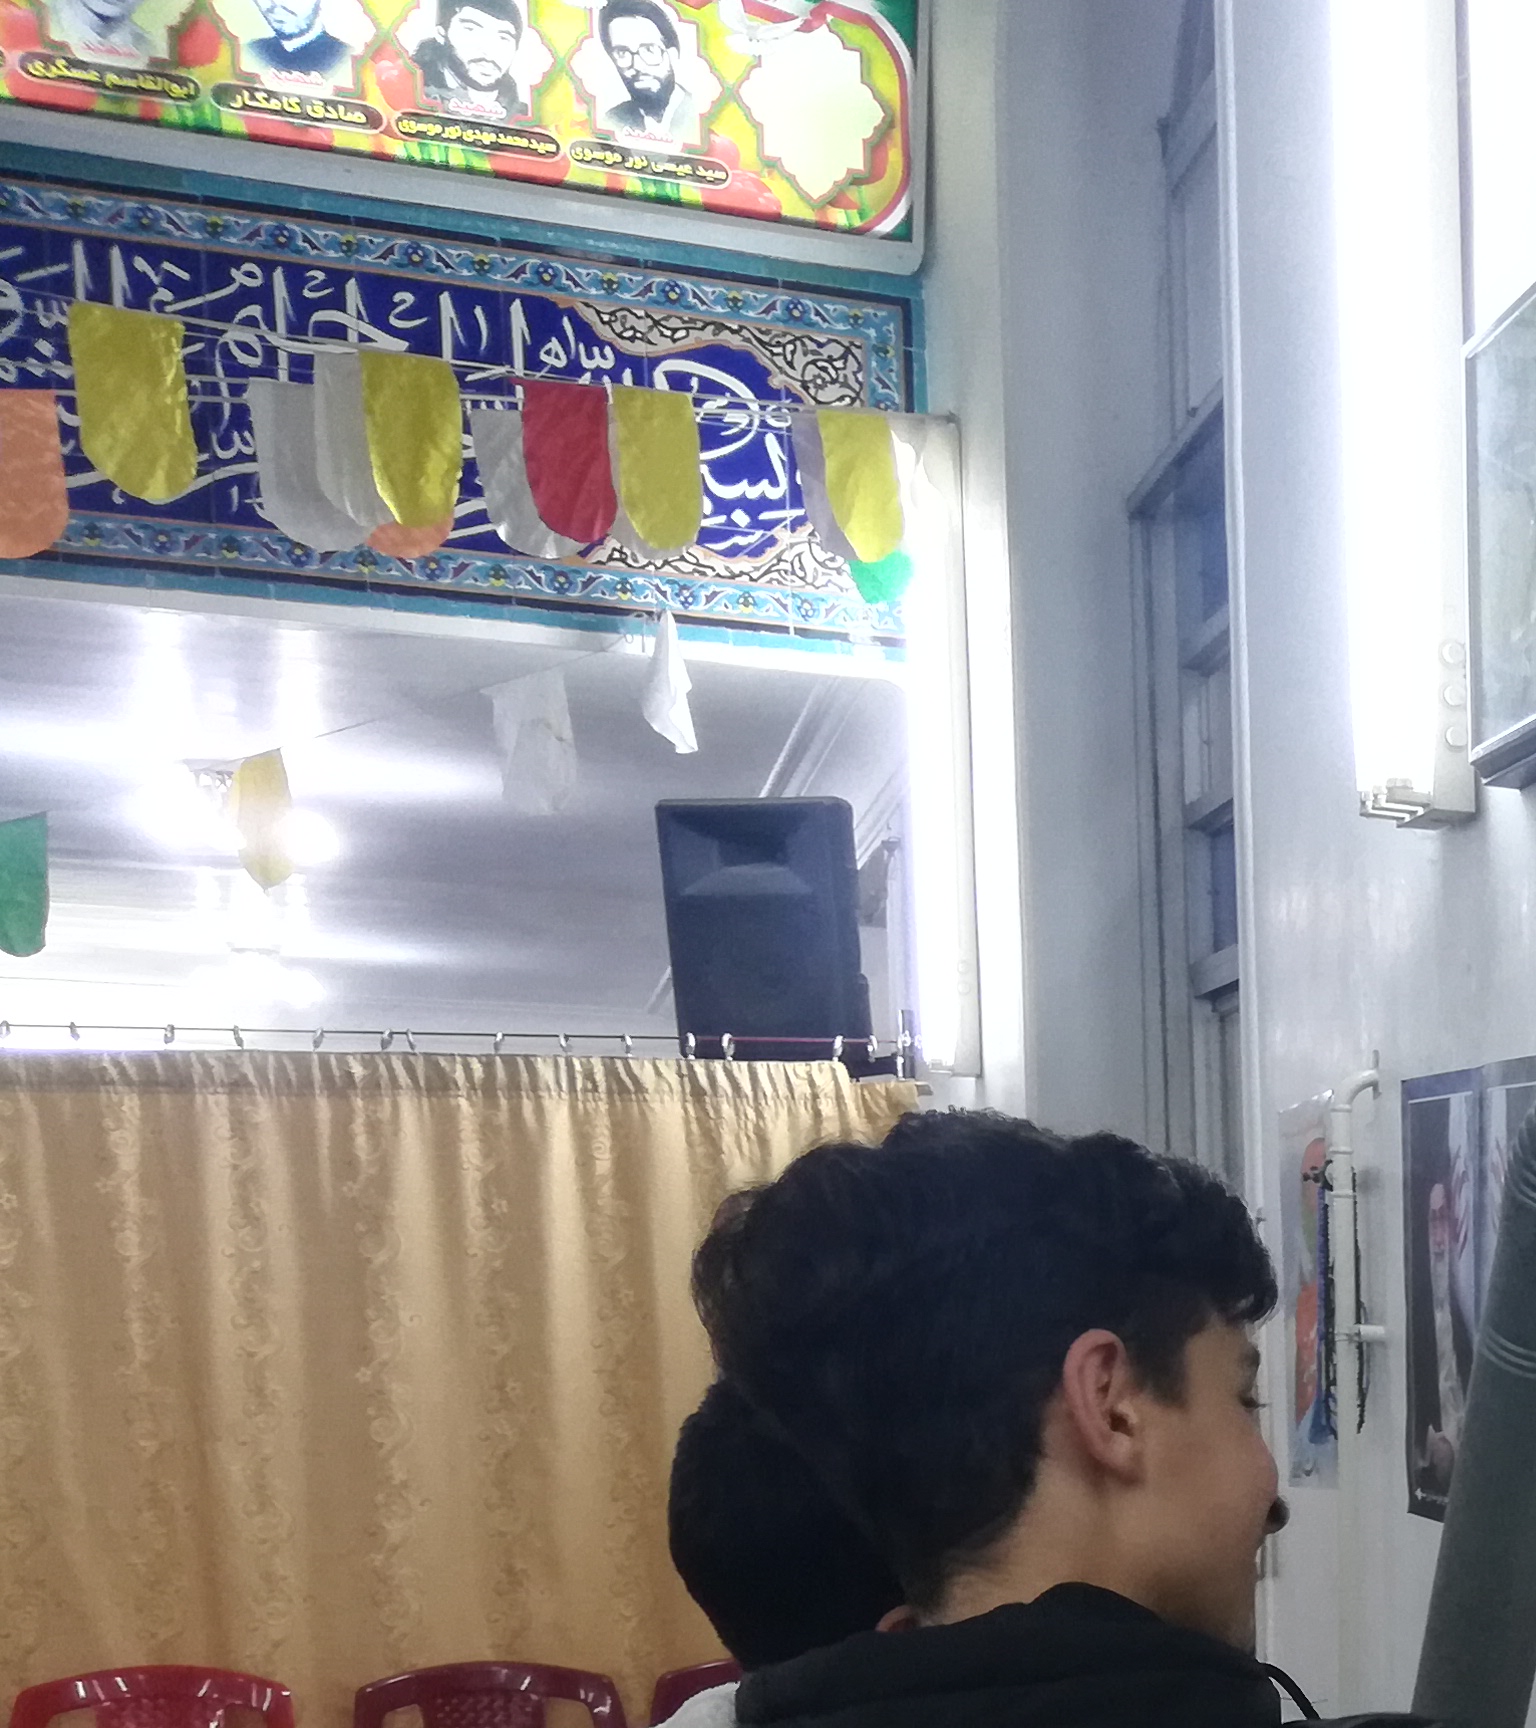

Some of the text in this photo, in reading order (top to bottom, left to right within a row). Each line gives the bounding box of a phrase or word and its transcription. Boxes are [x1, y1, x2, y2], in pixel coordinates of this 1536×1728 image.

[104, 72, 195, 99] ابوالقاسم
[230, 89, 367, 124] صادق کامکار
[397, 118, 443, 136] موسوی
[571, 146, 623, 166] موسوی
[650, 160, 694, 177] عیسی
[695, 164, 728, 182] سید
